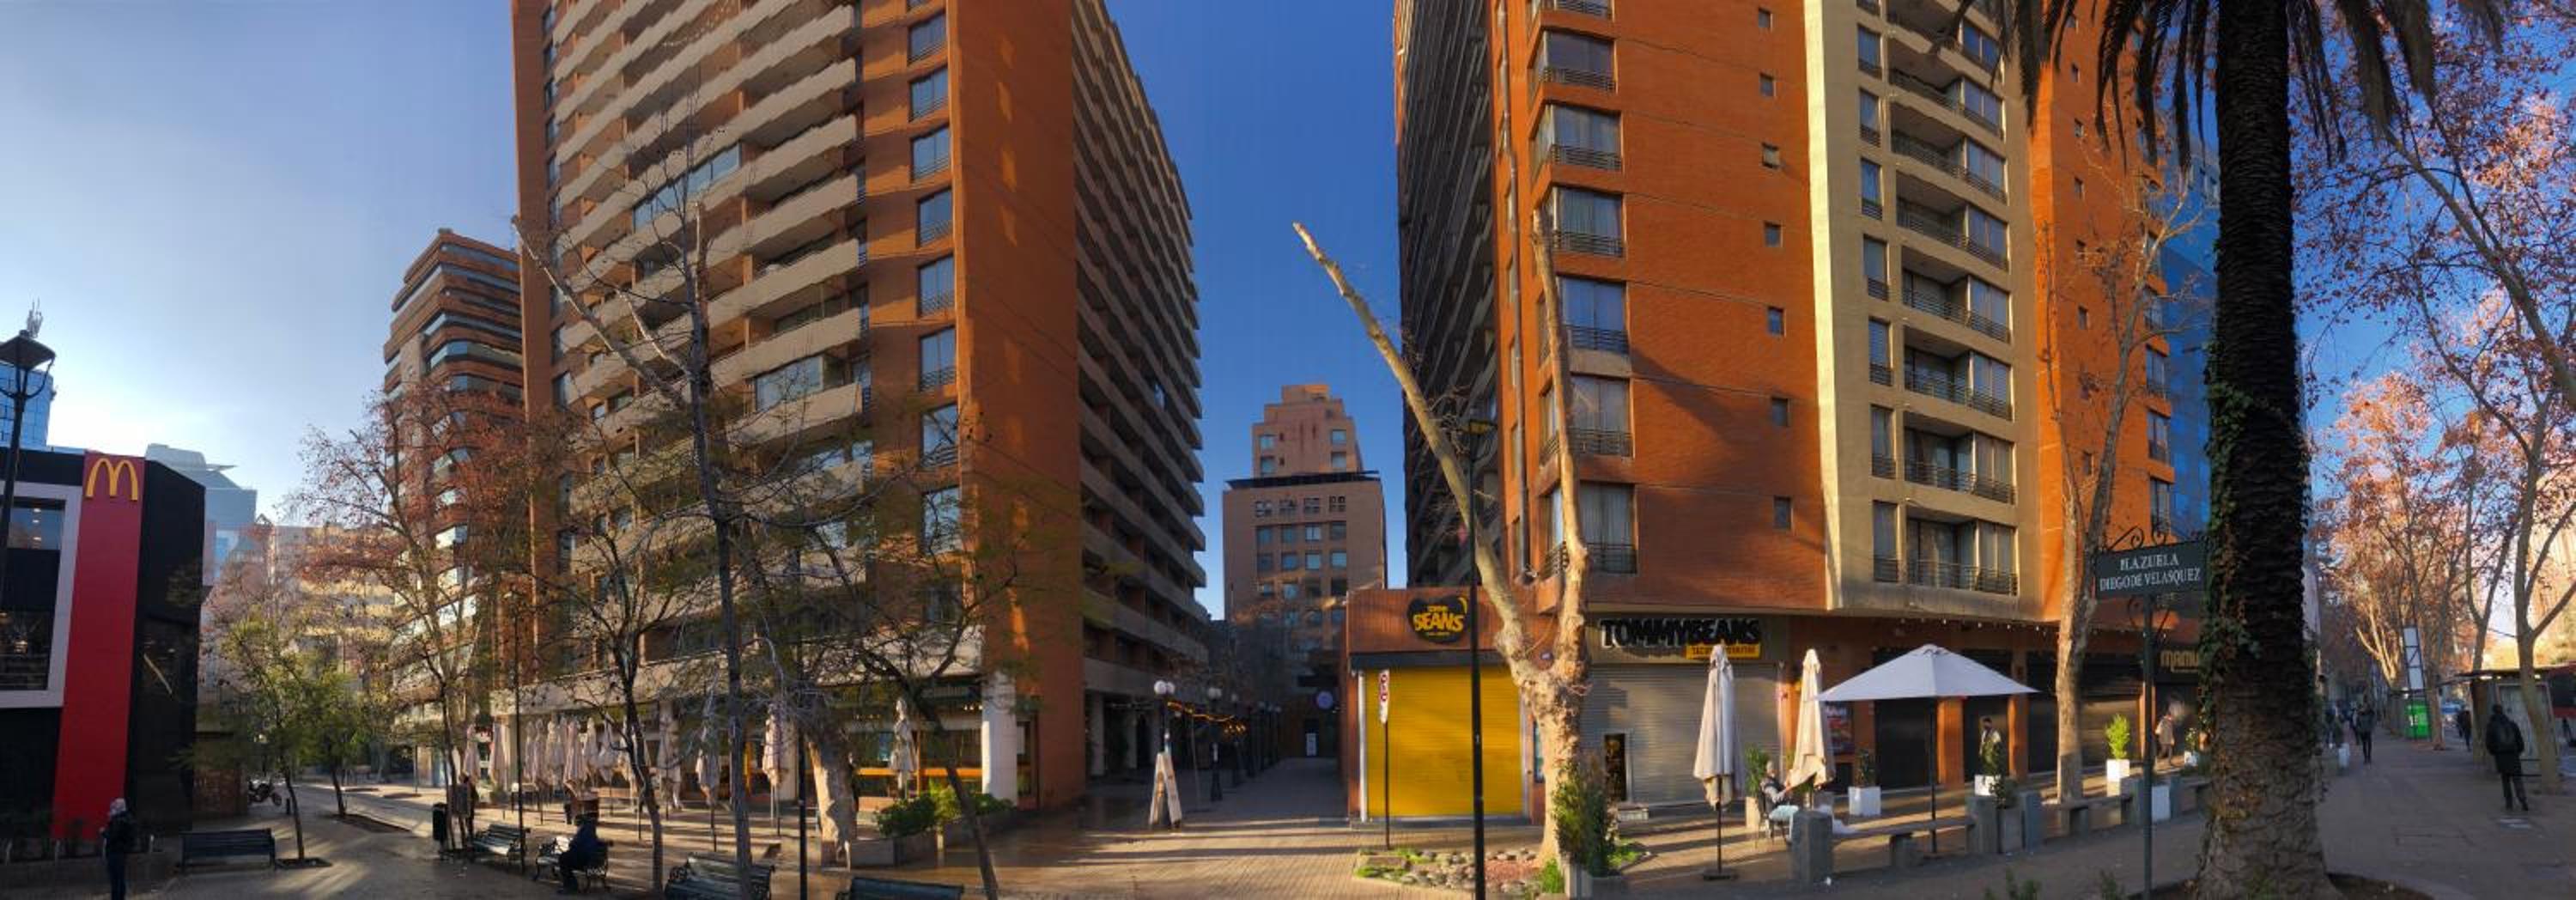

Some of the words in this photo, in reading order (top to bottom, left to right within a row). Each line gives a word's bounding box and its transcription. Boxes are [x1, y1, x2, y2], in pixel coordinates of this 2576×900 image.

[2119, 552, 2179, 571] PLAZUELA
[2099, 575, 2130, 592] DIEGO
[2144, 567, 2201, 587] VELASQUEZ
